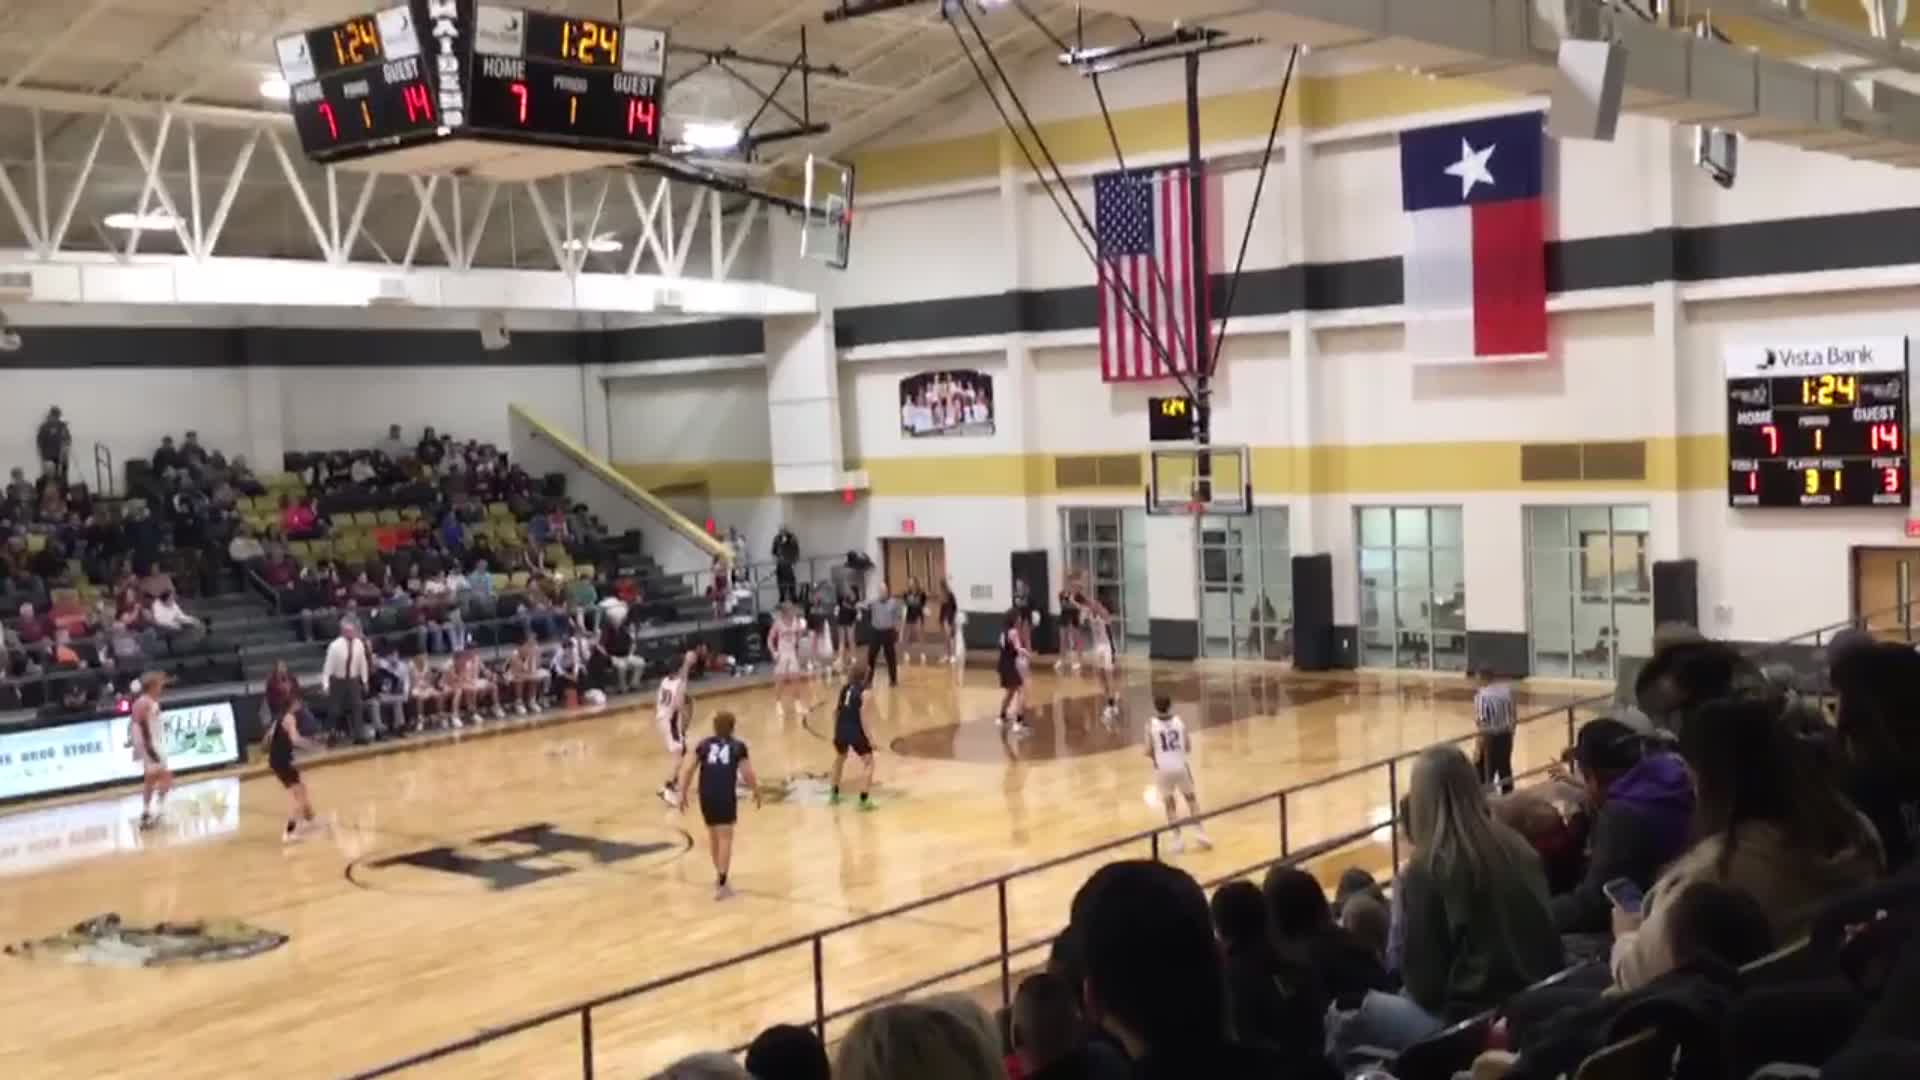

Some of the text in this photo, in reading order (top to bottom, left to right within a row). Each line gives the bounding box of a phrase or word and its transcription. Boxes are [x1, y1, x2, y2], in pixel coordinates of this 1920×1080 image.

[333, 21, 379, 65] 1:24
[562, 21, 618, 64] 1:24
[483, 58, 527, 78] HOME
[613, 73, 656, 96] GUEST
[404, 83, 432, 123] 14
[511, 83, 528, 123] 7
[569, 95, 577, 124] 1
[318, 102, 338, 139] 7
[627, 99, 655, 135] 14
[1779, 346, 1872, 366] Vista Bank
[1802, 374, 1856, 405] 1:24
[1737, 410, 1774, 425] HOME
[1853, 406, 1896, 422] GUEST
[1762, 426, 1778, 454] 7
[1815, 428, 1823, 451] 1
[1871, 424, 1898, 451] 14
[1749, 471, 1756, 493] 1
[1884, 468, 1898, 492] 3
[1160, 730, 1181, 752] 12
[707, 743, 730, 765] 24
